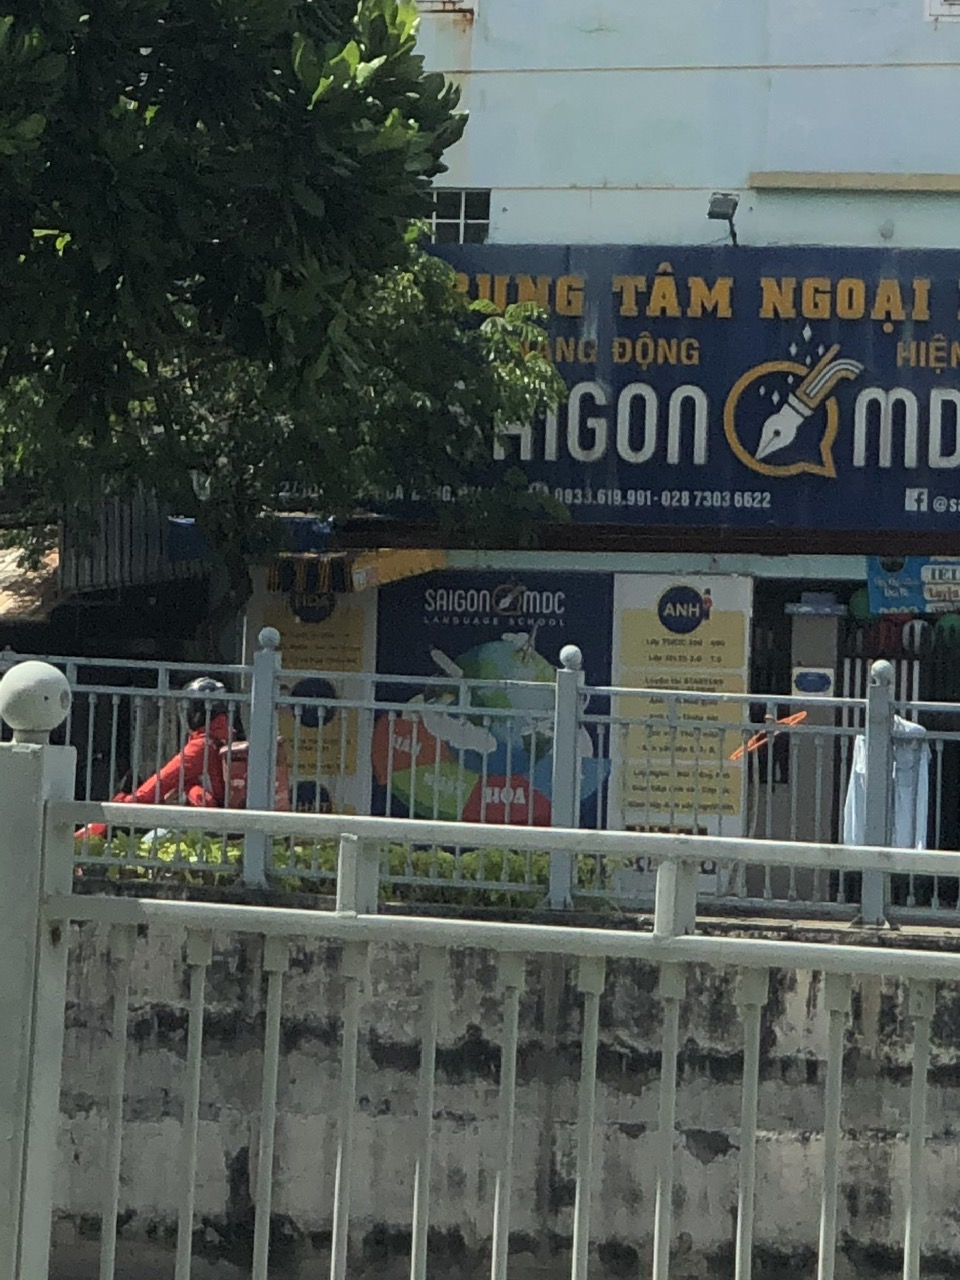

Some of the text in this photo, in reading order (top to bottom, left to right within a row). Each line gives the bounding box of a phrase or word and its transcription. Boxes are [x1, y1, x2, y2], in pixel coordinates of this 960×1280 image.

[453, 273, 585, 317] UNG
[612, 262, 733, 318] TÂM
[759, 277, 931, 333] NGOẠI
[612, 331, 700, 371] ĐỘNG
[493, 381, 708, 465] AIGON
[693, 490, 732, 507] 7303
[733, 491, 772, 508] 6622
[424, 589, 566, 614] SAIGON MDC
[662, 603, 700, 617] ANH
[424, 616, 566, 627] LANGUAGE SCHOOL
